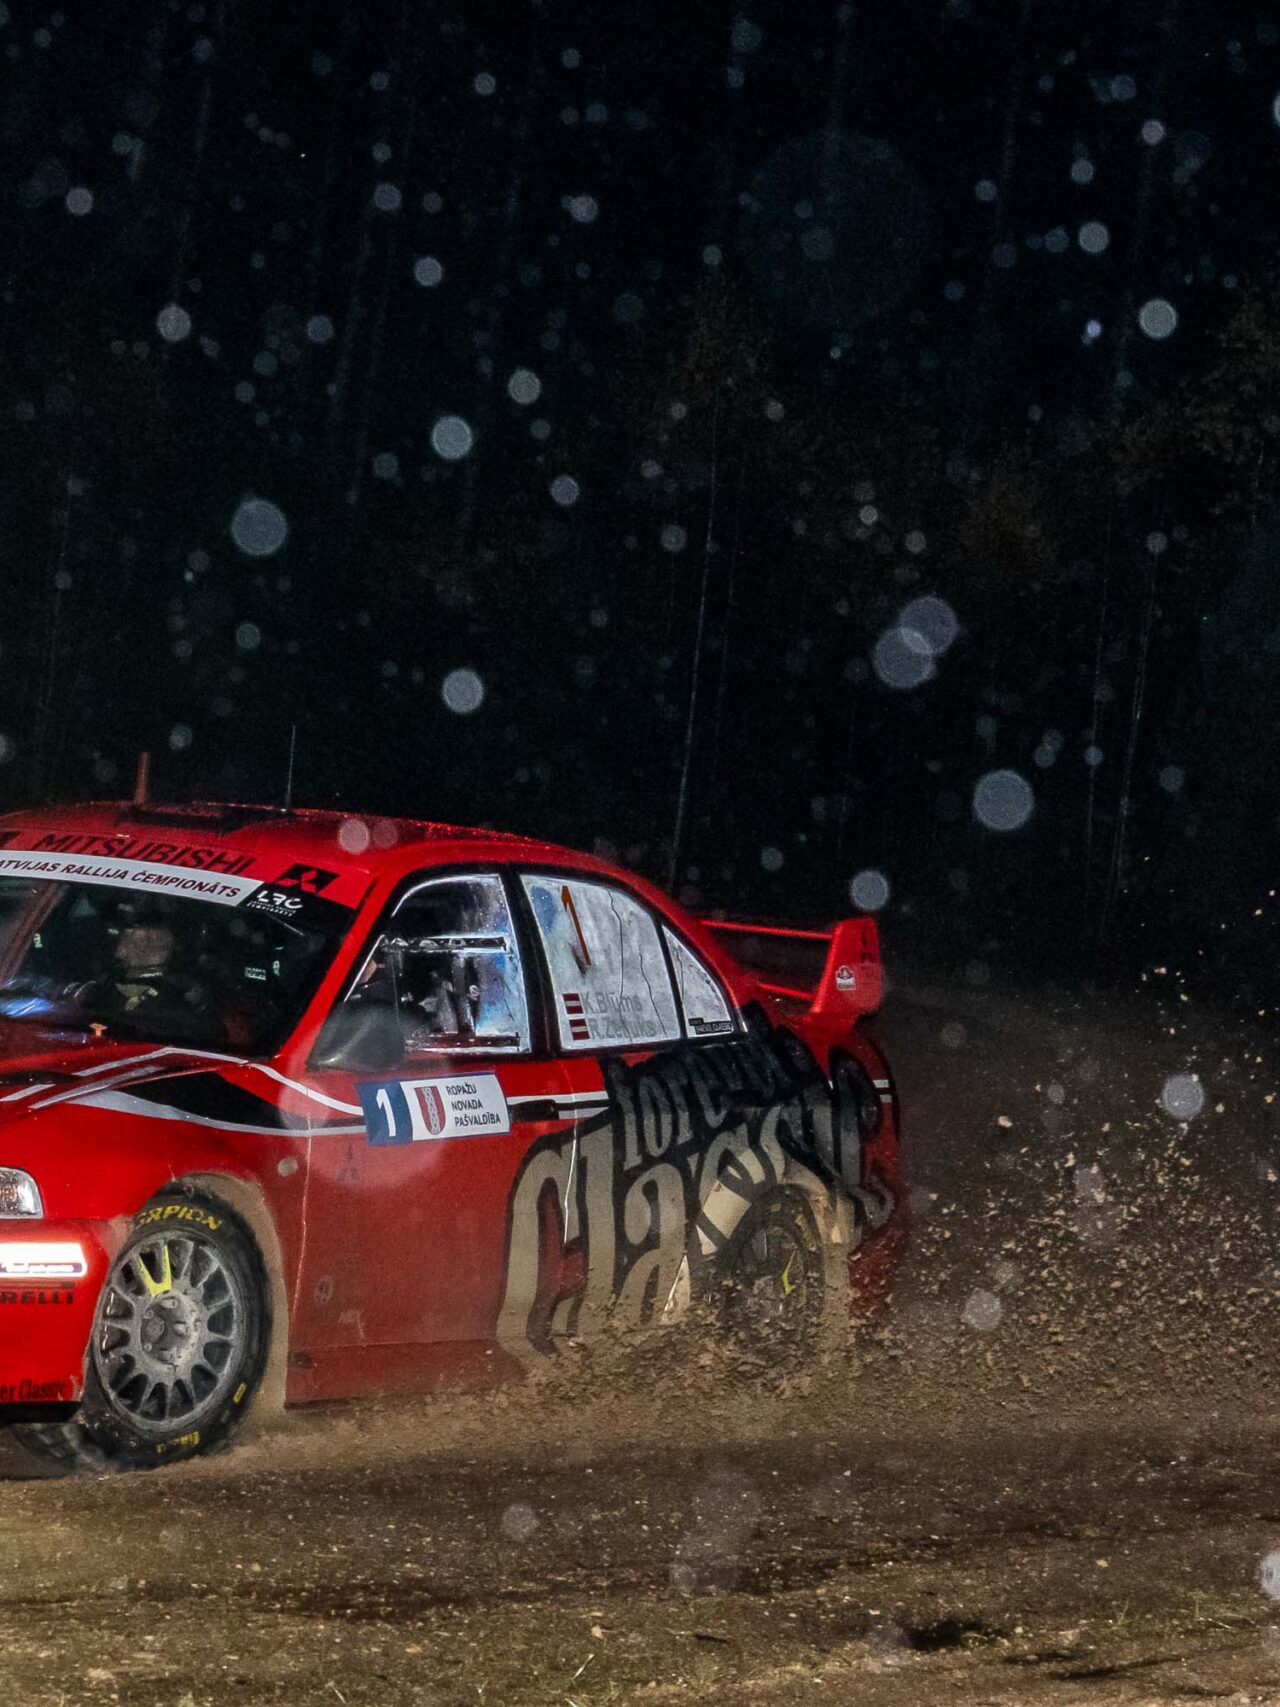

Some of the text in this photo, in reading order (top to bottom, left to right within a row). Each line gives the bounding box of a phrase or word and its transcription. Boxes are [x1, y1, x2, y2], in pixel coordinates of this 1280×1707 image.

[31, 833, 257, 876] MITSUBISHI
[61, 863, 128, 880] RALLIJA
[131, 870, 241, 897] ČEMPIONĀTS
[445, 1082, 477, 1096] ROPAŽU
[376, 1088, 397, 1137] 1
[451, 1100, 483, 1111] NOVADA
[454, 1111, 501, 1127] PAŠVALDĪBA
